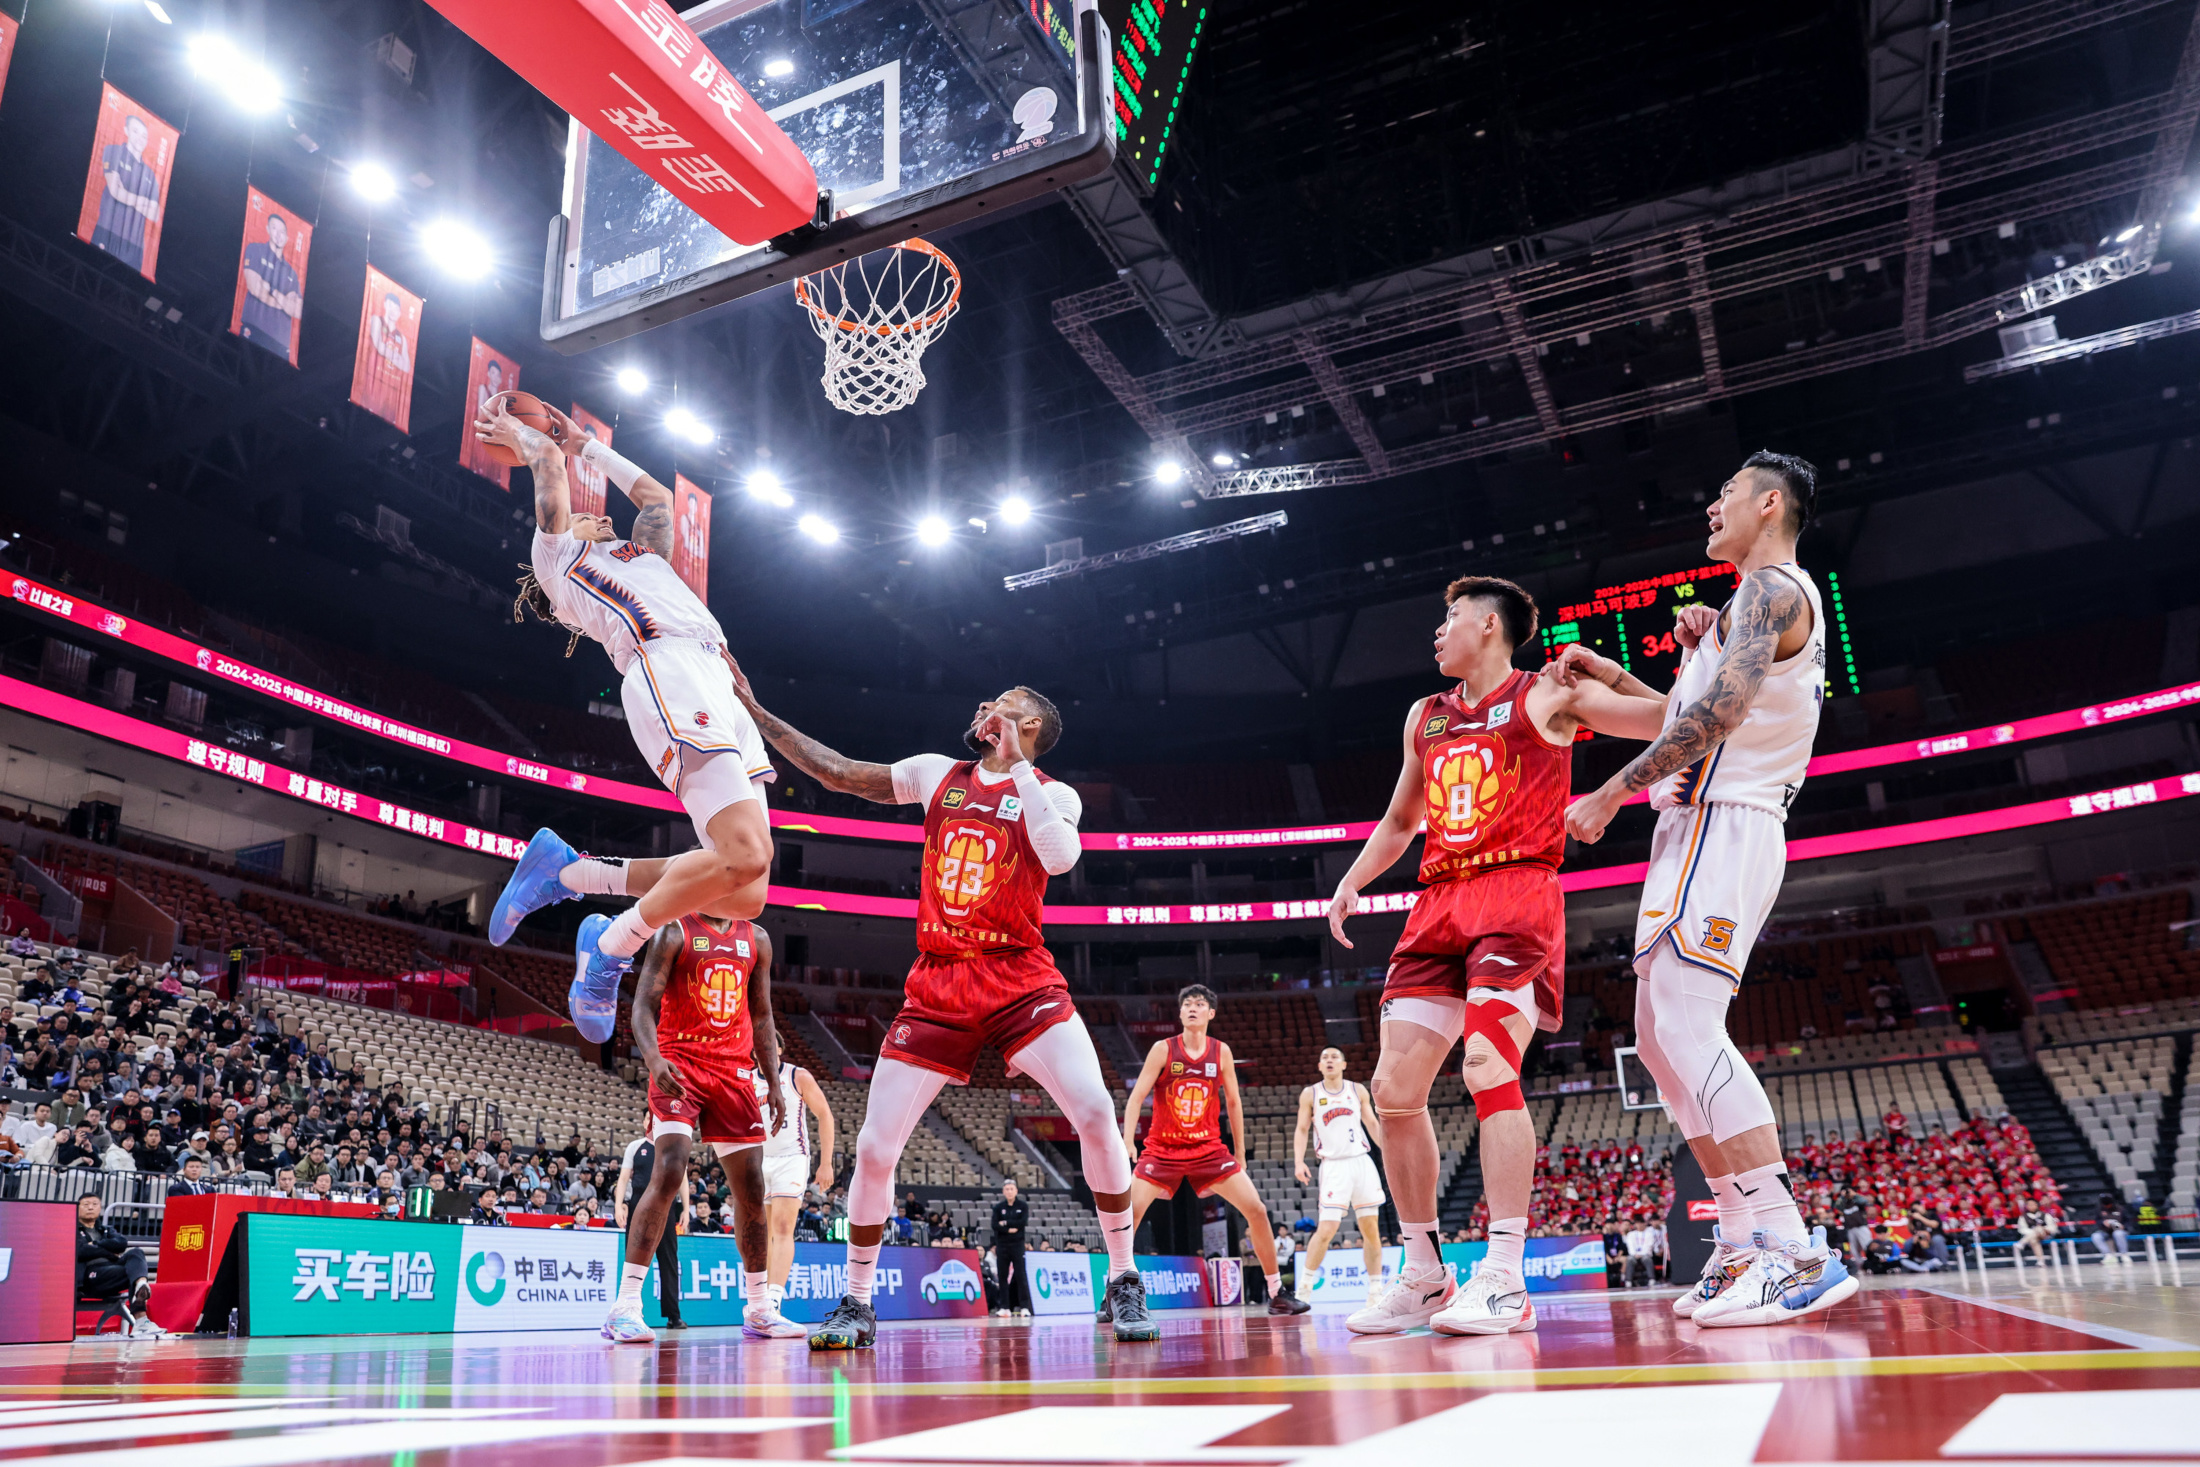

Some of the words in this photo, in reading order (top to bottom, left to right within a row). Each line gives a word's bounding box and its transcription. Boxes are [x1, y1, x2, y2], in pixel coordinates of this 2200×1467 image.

[30, 586, 73, 616] 以诚之名
[1674, 583, 1695, 599] VS
[1558, 589, 1658, 623] 深圳马可波罗
[1641, 632, 1677, 657] 34
[187, 740, 266, 785] 遵守规则
[287, 773, 357, 812] 尊重对手
[378, 803, 444, 839] 尊重裁判
[1449, 781, 1473, 822] 8
[941, 856, 986, 896] 23
[1189, 904, 1253, 922] 尊重对手
[706, 989, 737, 1013] 35
[1179, 1099, 1204, 1117] 33
[176, 1232, 205, 1251] 深圳
[292, 1248, 436, 1303] 买车险
[515, 1256, 606, 1284] 中国人寿
[1052, 1270, 1086, 1286] 中国人寿
[517, 1288, 569, 1302] CHINA
[575, 1288, 607, 1302] LIFE
[1055, 1288, 1074, 1297] CHINA
[1076, 1288, 1089, 1297] LIFE
[1331, 1280, 1364, 1289] CHINA
